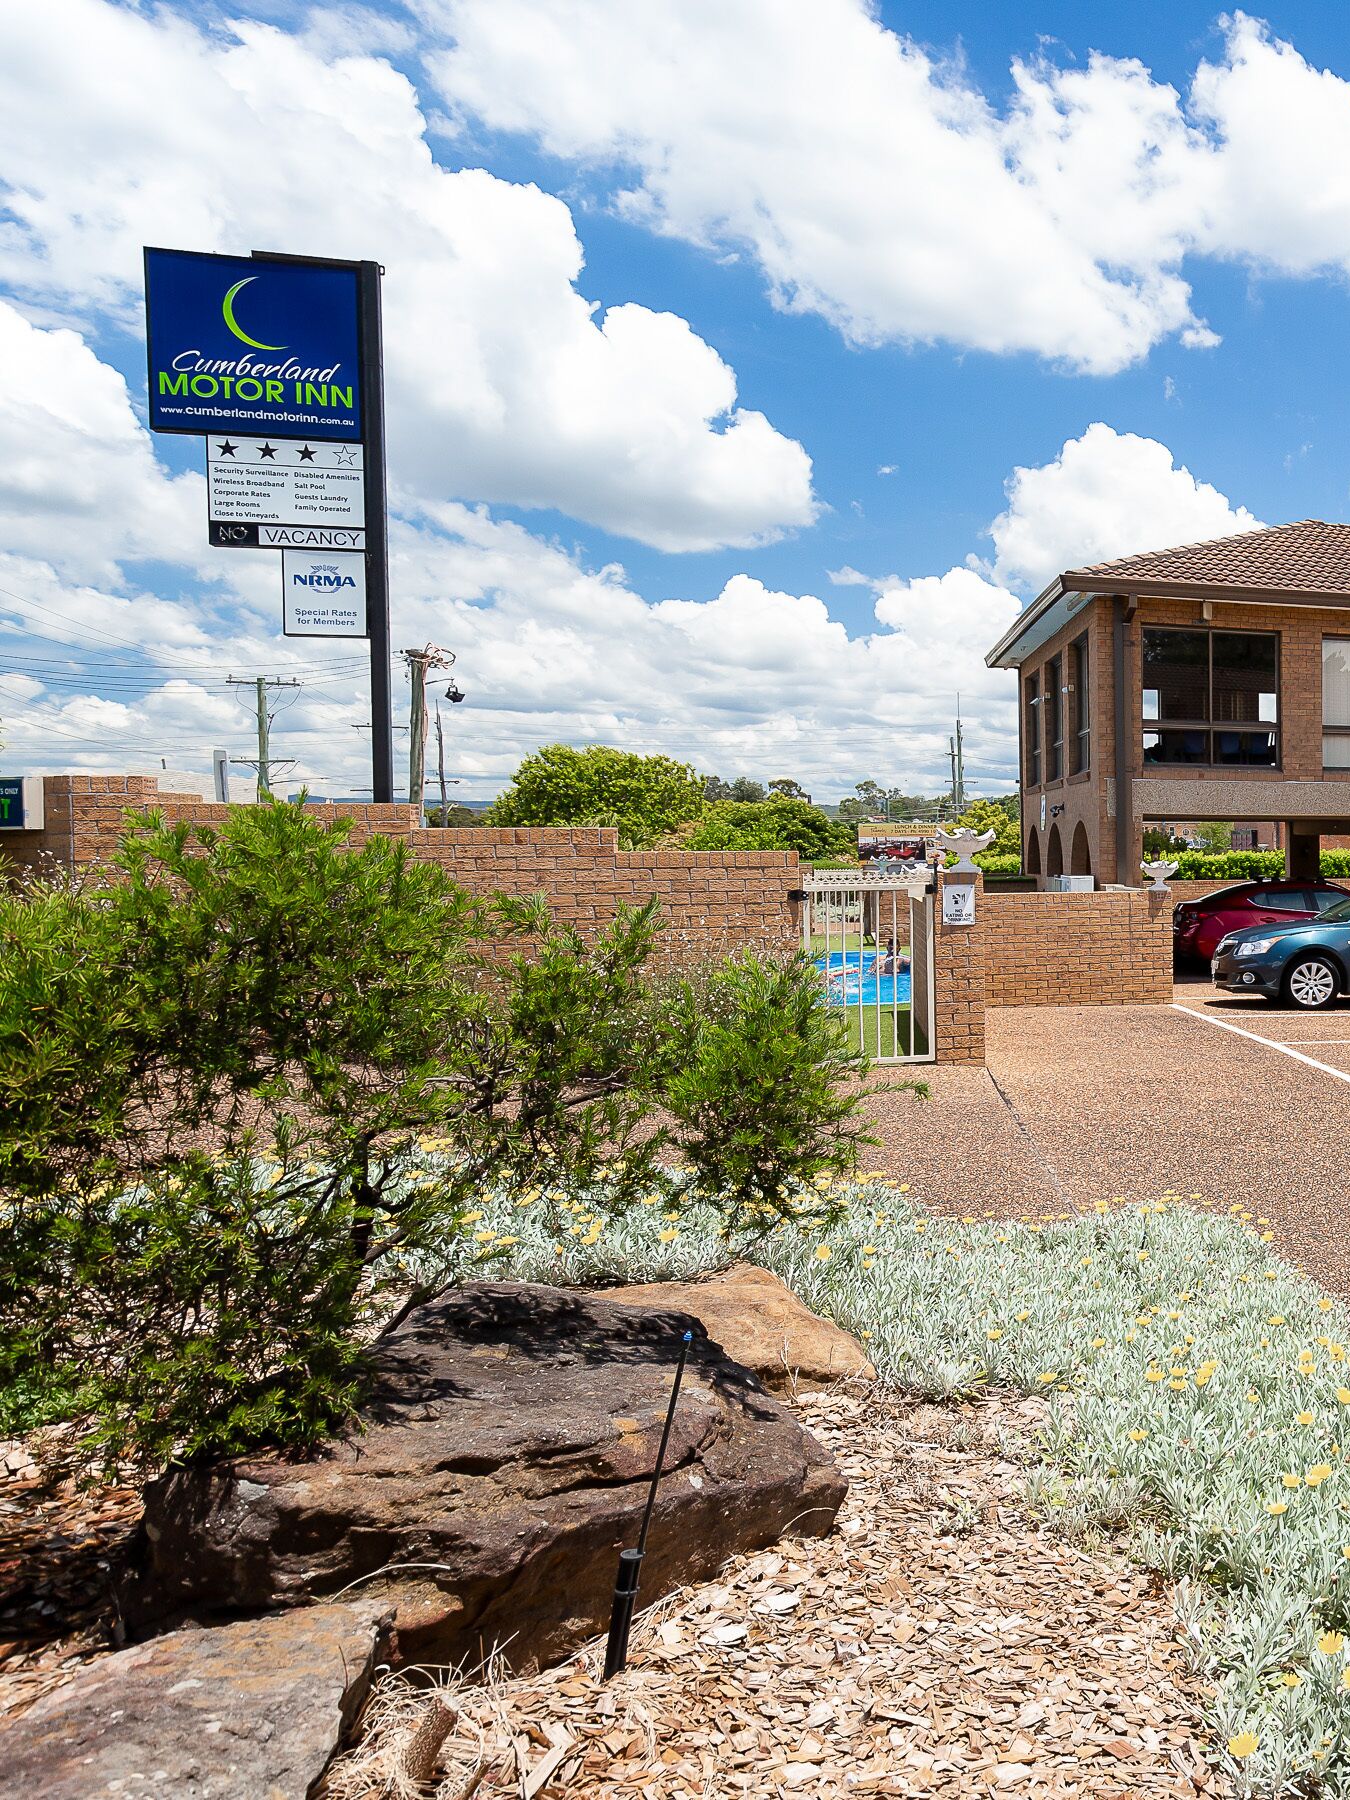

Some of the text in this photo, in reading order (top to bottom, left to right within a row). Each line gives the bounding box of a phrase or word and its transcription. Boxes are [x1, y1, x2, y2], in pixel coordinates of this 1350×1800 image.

[172, 350, 340, 383] Cumberland
[159, 371, 353, 408] MOTOR INN
[160, 406, 354, 426] www.cumberlandmotorinn.com.au
[213, 466, 289, 477] Security Surveillance
[293, 471, 360, 481] Disabled Amenities
[213, 477, 285, 488] Wireless Broadband
[213, 488, 271, 498] Corporate Rates
[214, 499, 260, 508] Large Rooms
[320, 494, 348, 503] Laundry
[294, 504, 351, 513] Family Operated
[244, 511, 280, 520] Vineyards
[219, 526, 360, 546] NO VACANCY
[293, 574, 356, 588] NRMA
[295, 608, 357, 617] Special Rates
[297, 617, 355, 626] for Members
